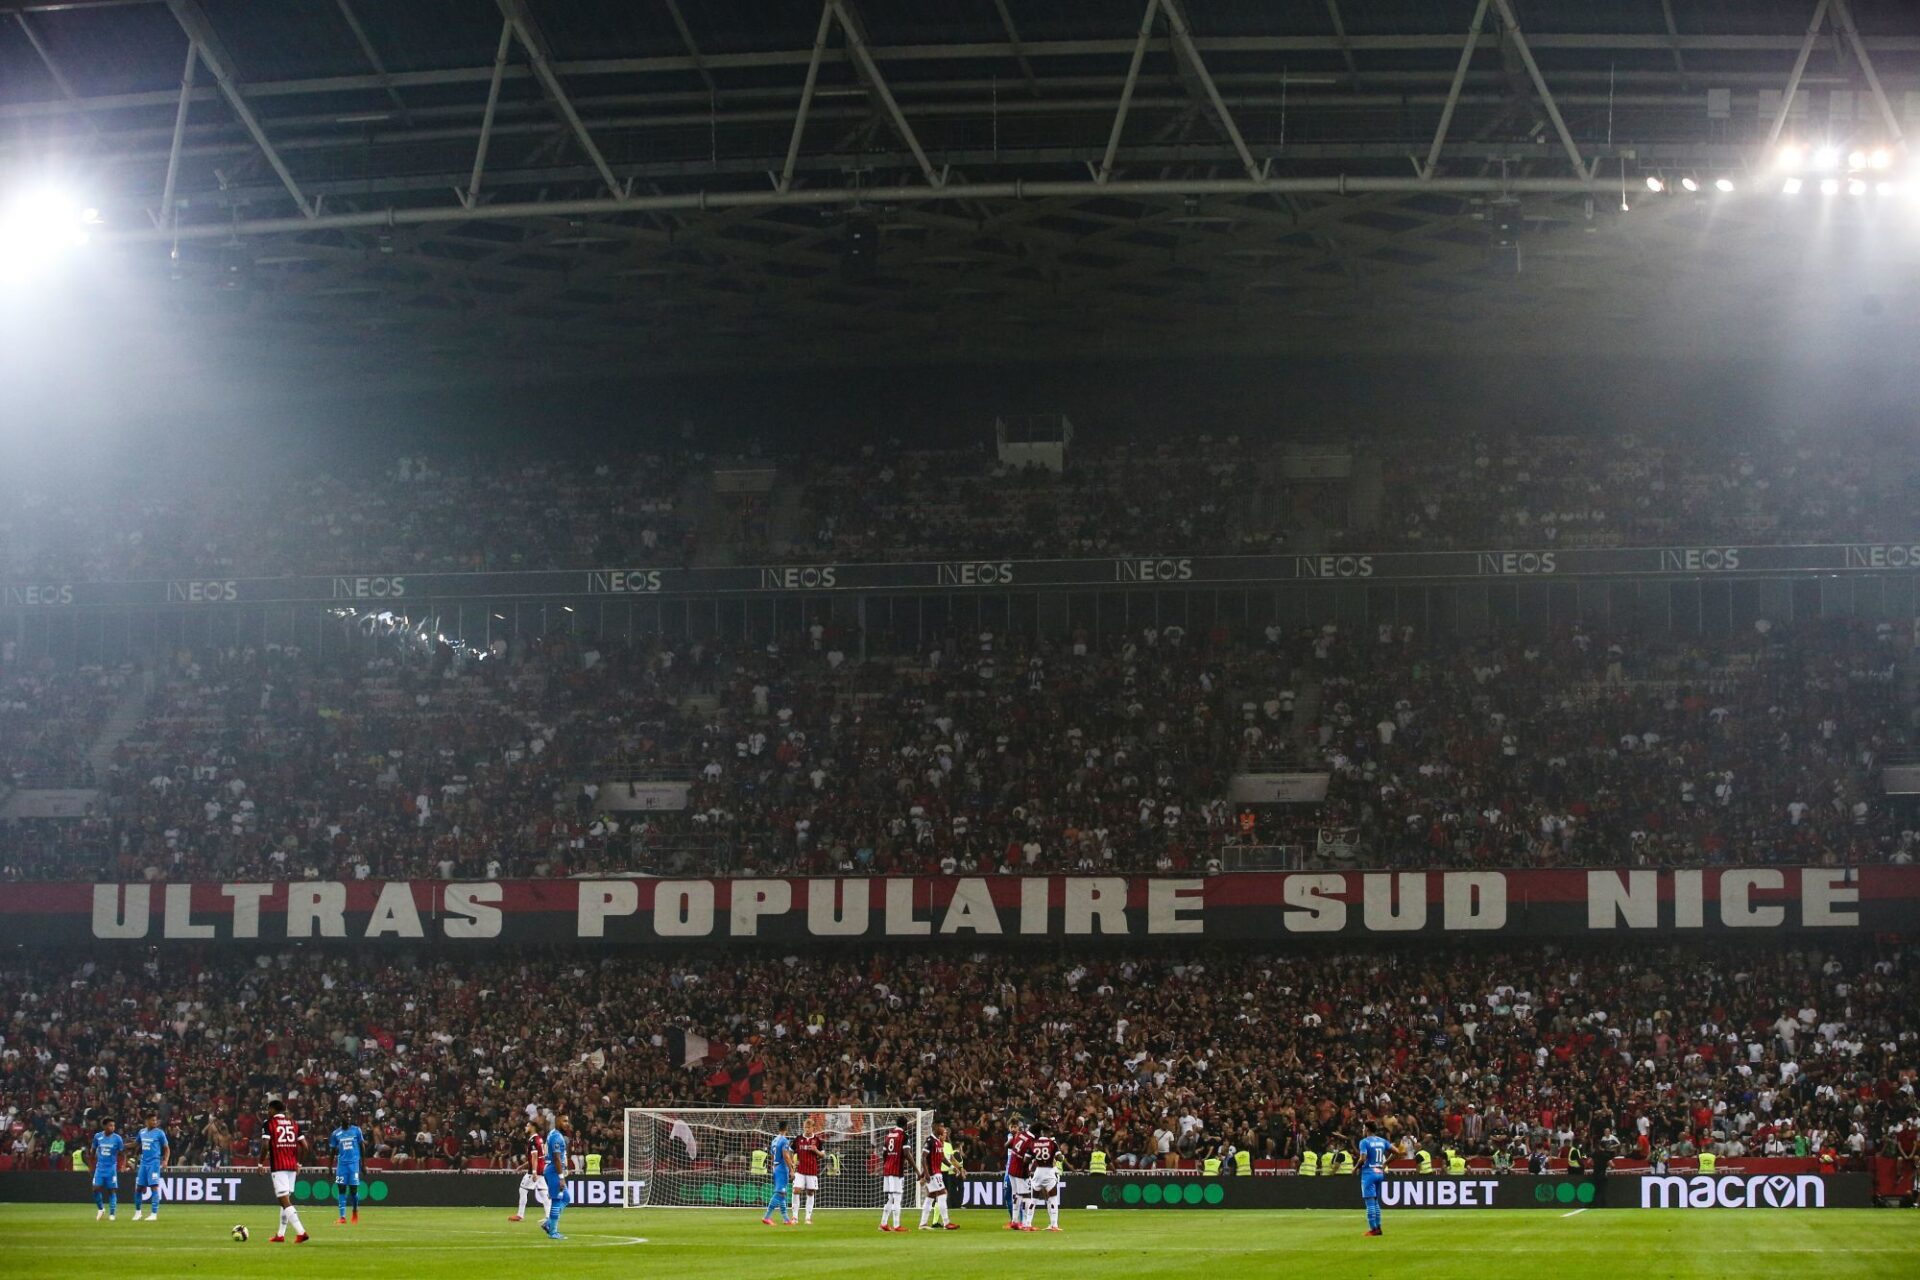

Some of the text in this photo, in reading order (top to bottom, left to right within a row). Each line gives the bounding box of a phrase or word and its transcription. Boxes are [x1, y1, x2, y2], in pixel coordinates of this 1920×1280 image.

[1296, 556, 1373, 578] INEOS
[1478, 552, 1556, 574] INEOS
[1661, 549, 1739, 571] INEOS
[1846, 546, 1920, 567] INEOS
[587, 570, 662, 592] INEOS
[761, 566, 837, 589] INEOS
[937, 562, 1013, 585] INEOS
[1116, 559, 1193, 581] INEOS
[4, 585, 73, 605] INEOS
[167, 581, 238, 602] INEOS
[333, 576, 405, 599] INEOS
[92, 866, 1861, 940] ULTRAS POPULAIRE SUD NICE
[277, 1126, 296, 1143] 25
[888, 1139, 895, 1152] 8
[1014, 1139, 1023, 1152] 4
[1033, 1147, 1050, 1161] 28
[1374, 1148, 1384, 1163] 11
[142, 1178, 242, 1202] NIBET
[335, 1176, 344, 1184] 22
[1641, 1174, 1825, 1208] macron
[1381, 1179, 1499, 1206] UNIBET
